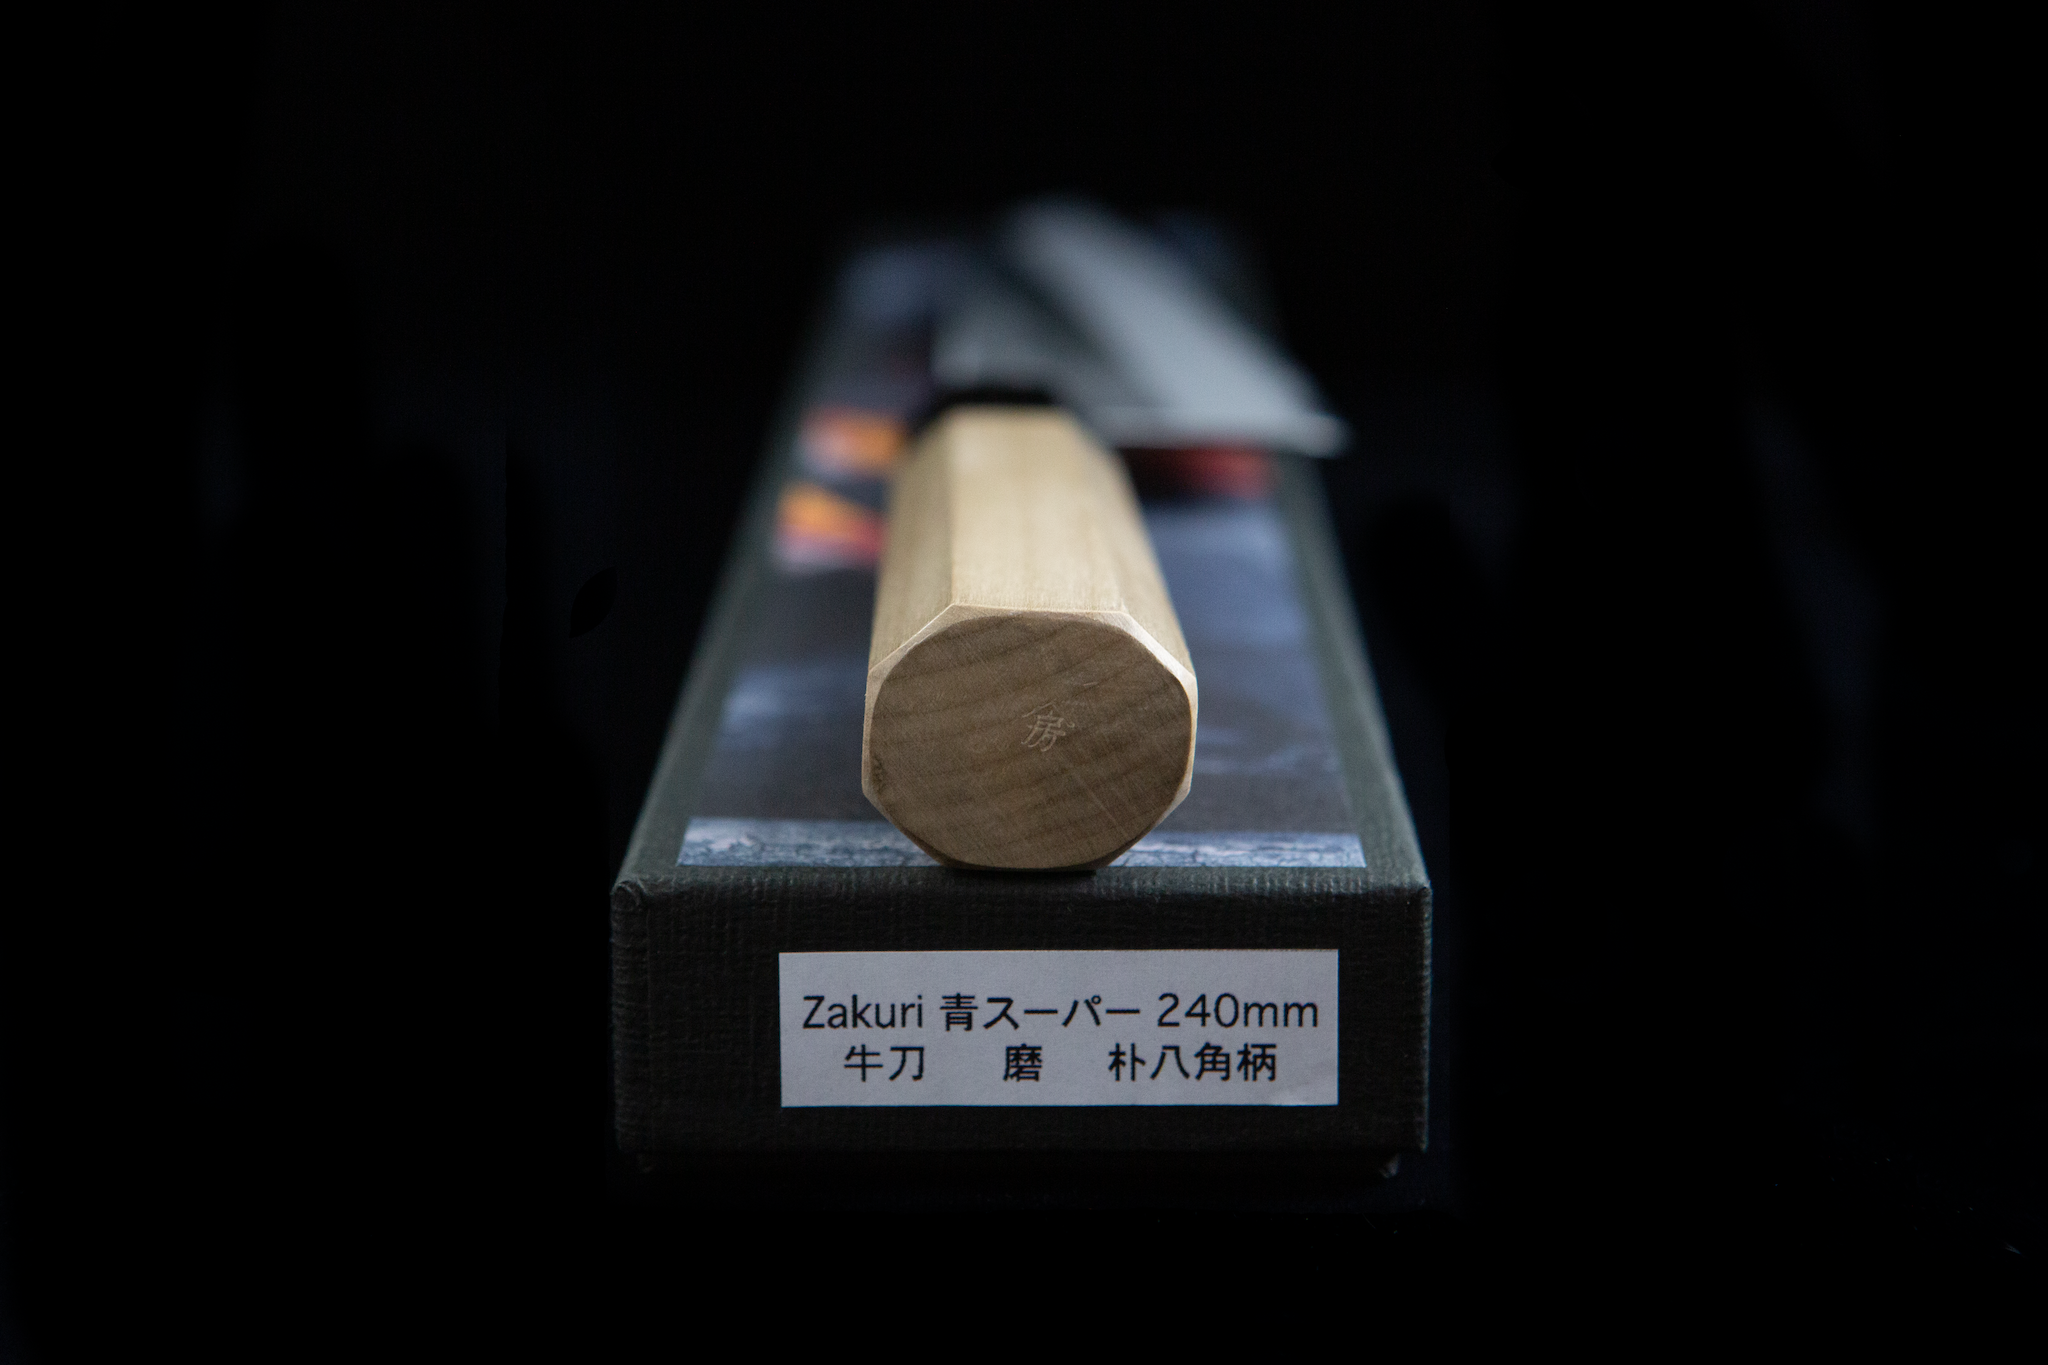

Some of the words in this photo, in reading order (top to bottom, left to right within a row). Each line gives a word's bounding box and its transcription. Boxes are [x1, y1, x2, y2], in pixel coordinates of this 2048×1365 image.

[801, 992, 924, 1030] Zakuri
[938, 991, 1142, 1033] 青スーパー
[1156, 991, 1320, 1030] 240mm
[842, 1042, 926, 1084] 牛刀
[1002, 1042, 1044, 1083] 磨
[1107, 1039, 1278, 1083] 朴八角柄
